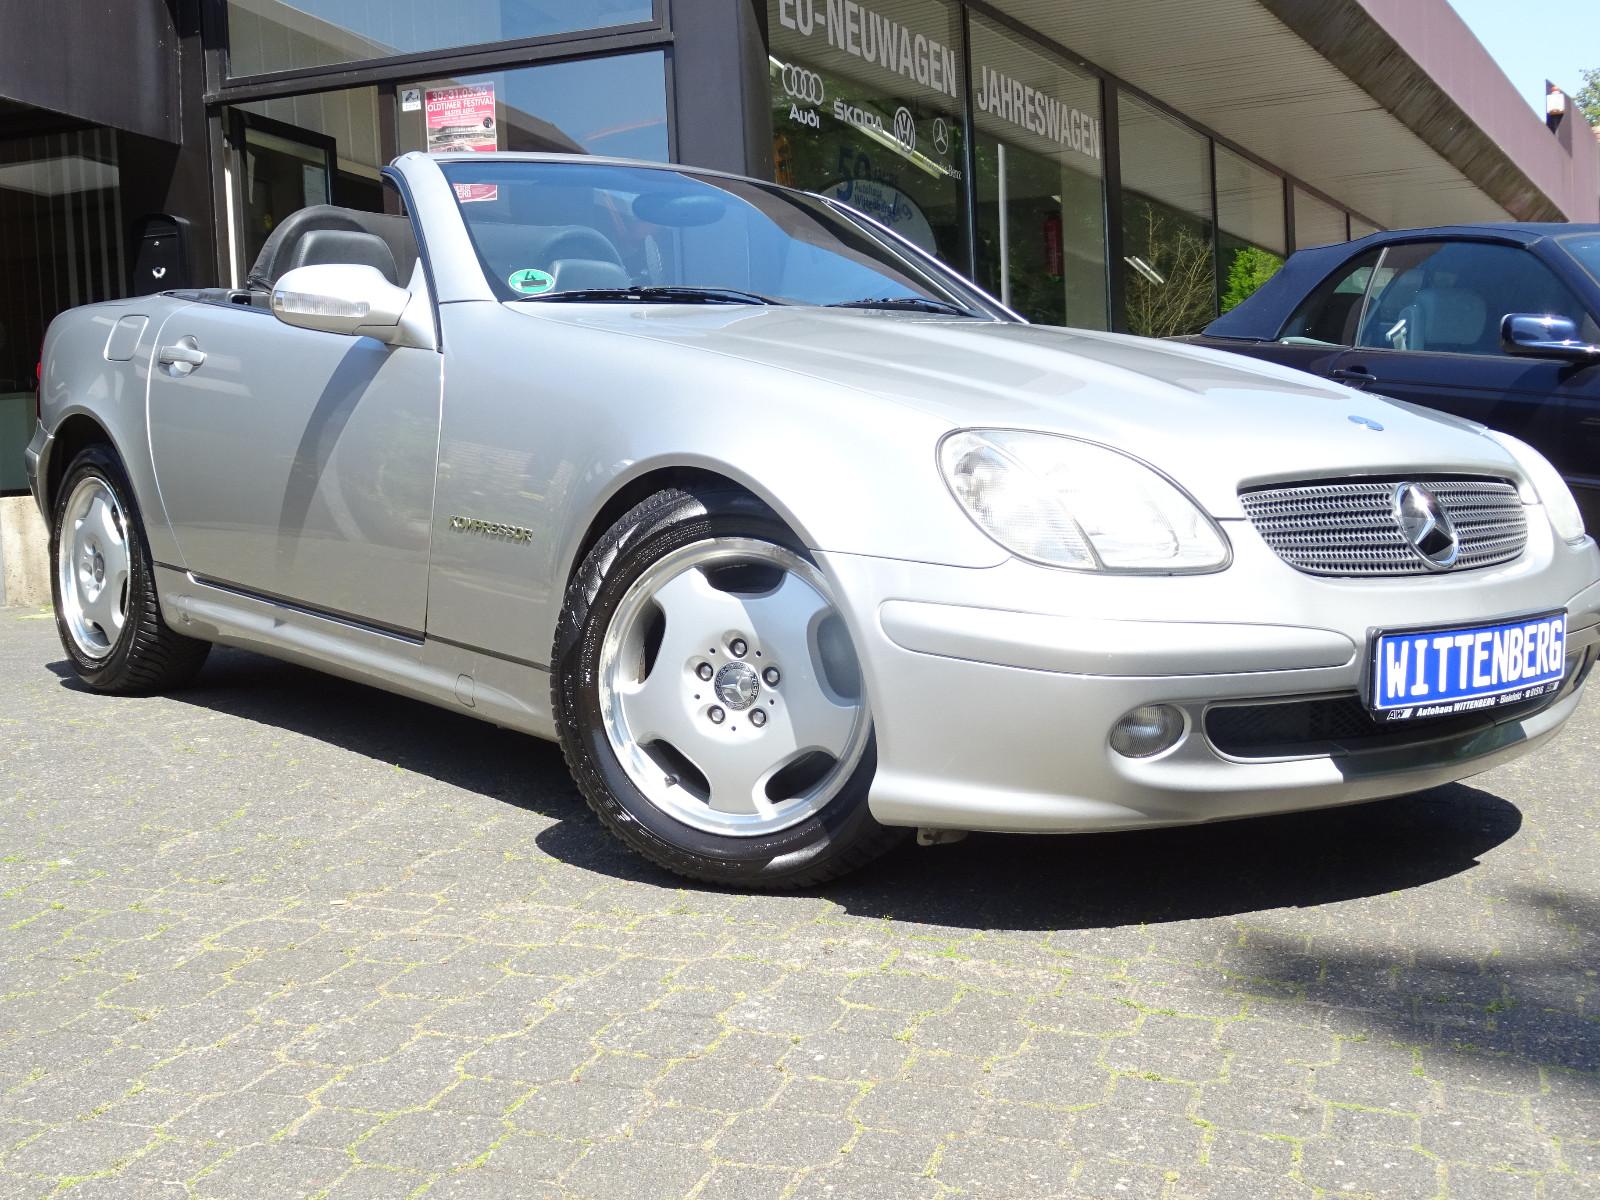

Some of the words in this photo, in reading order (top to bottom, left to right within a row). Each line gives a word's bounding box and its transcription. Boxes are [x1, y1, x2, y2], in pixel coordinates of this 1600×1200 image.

[779, 0, 957, 98] EU-NEUWAGEN
[463, 96, 494, 107] FESTIVAL
[789, 103, 820, 129] Audi
[833, 98, 883, 135] ŠKODA
[978, 65, 1100, 160] JAHRESWAGEN
[449, 514, 534, 542] KOMPRESSOR
[1386, 619, 1563, 698] WITTENBERG
[1416, 704, 1453, 717] Autohaus
[1453, 696, 1496, 712] WITTENBERG
